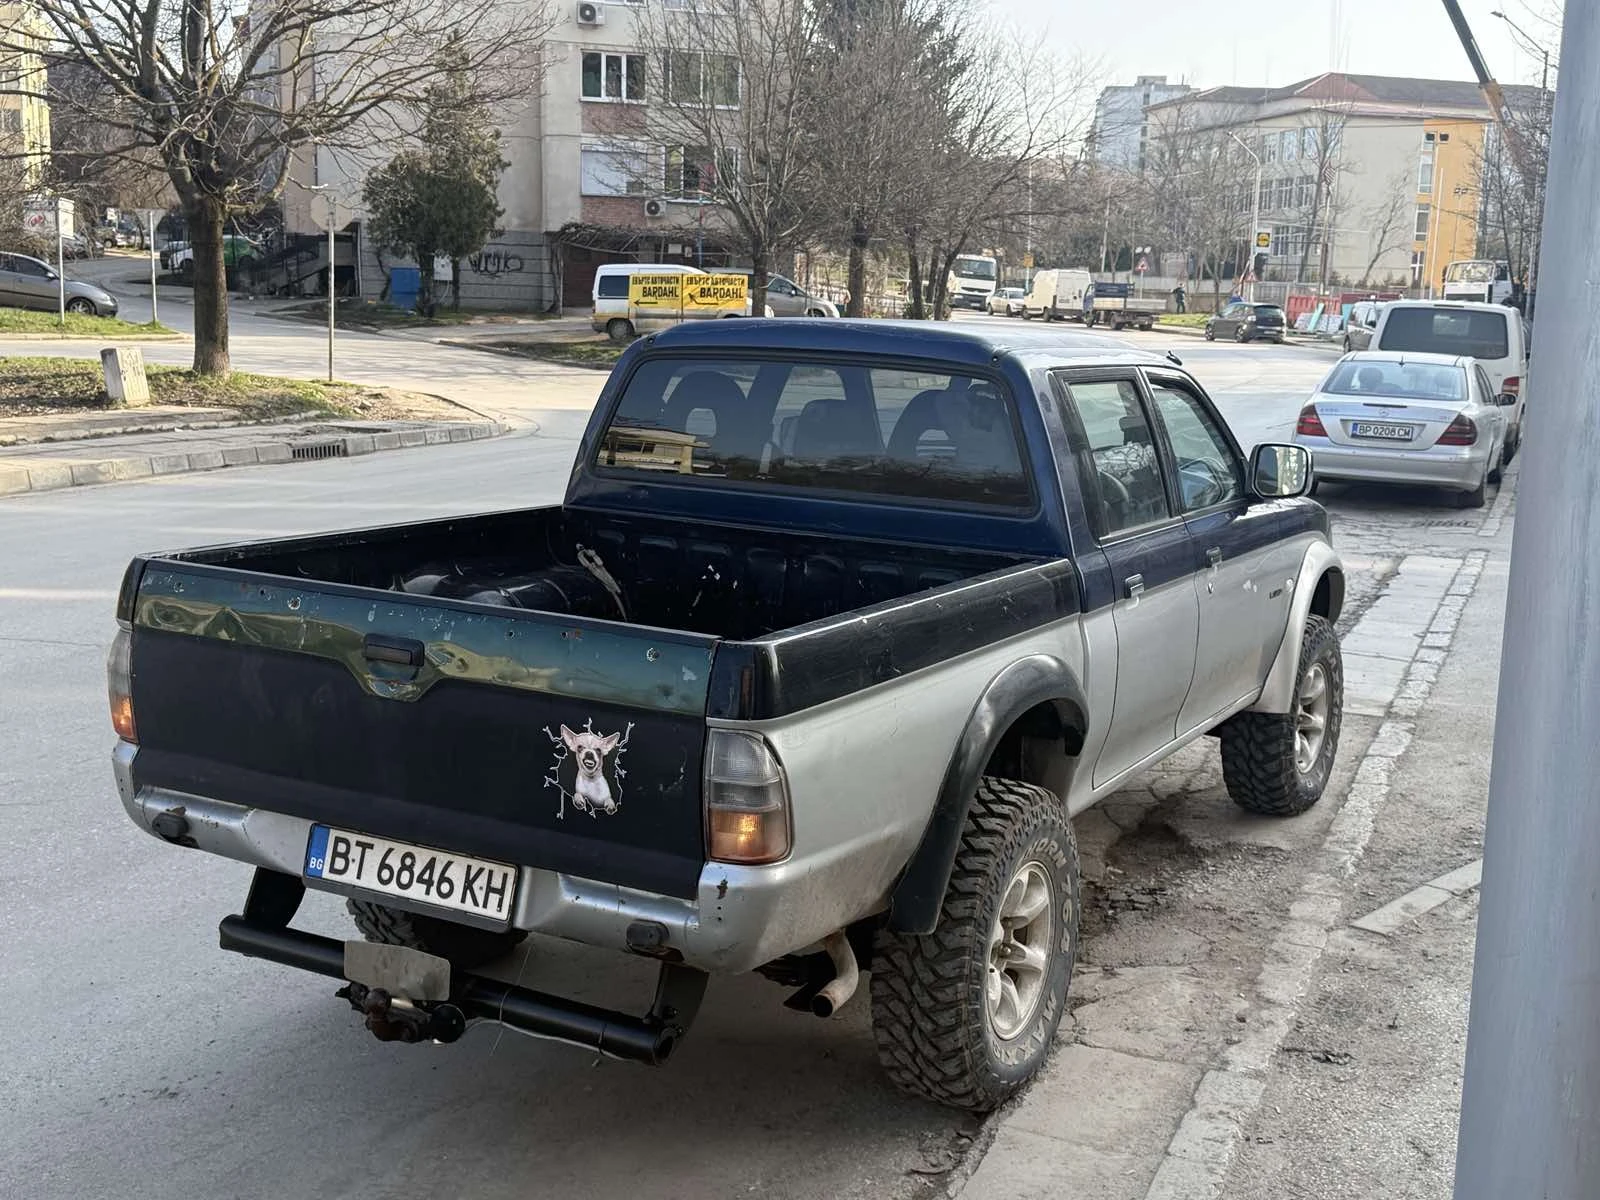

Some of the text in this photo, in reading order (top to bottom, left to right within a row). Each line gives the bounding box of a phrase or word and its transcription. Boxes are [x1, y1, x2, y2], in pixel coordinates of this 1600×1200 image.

[711, 277, 745, 287] АВТОЧАСТИ
[642, 286, 679, 299] BARDAHL
[700, 287, 744, 301] BARDAHL
[1373, 426, 1395, 437] 0208
[309, 835, 509, 914] BG BT 6846 KH
